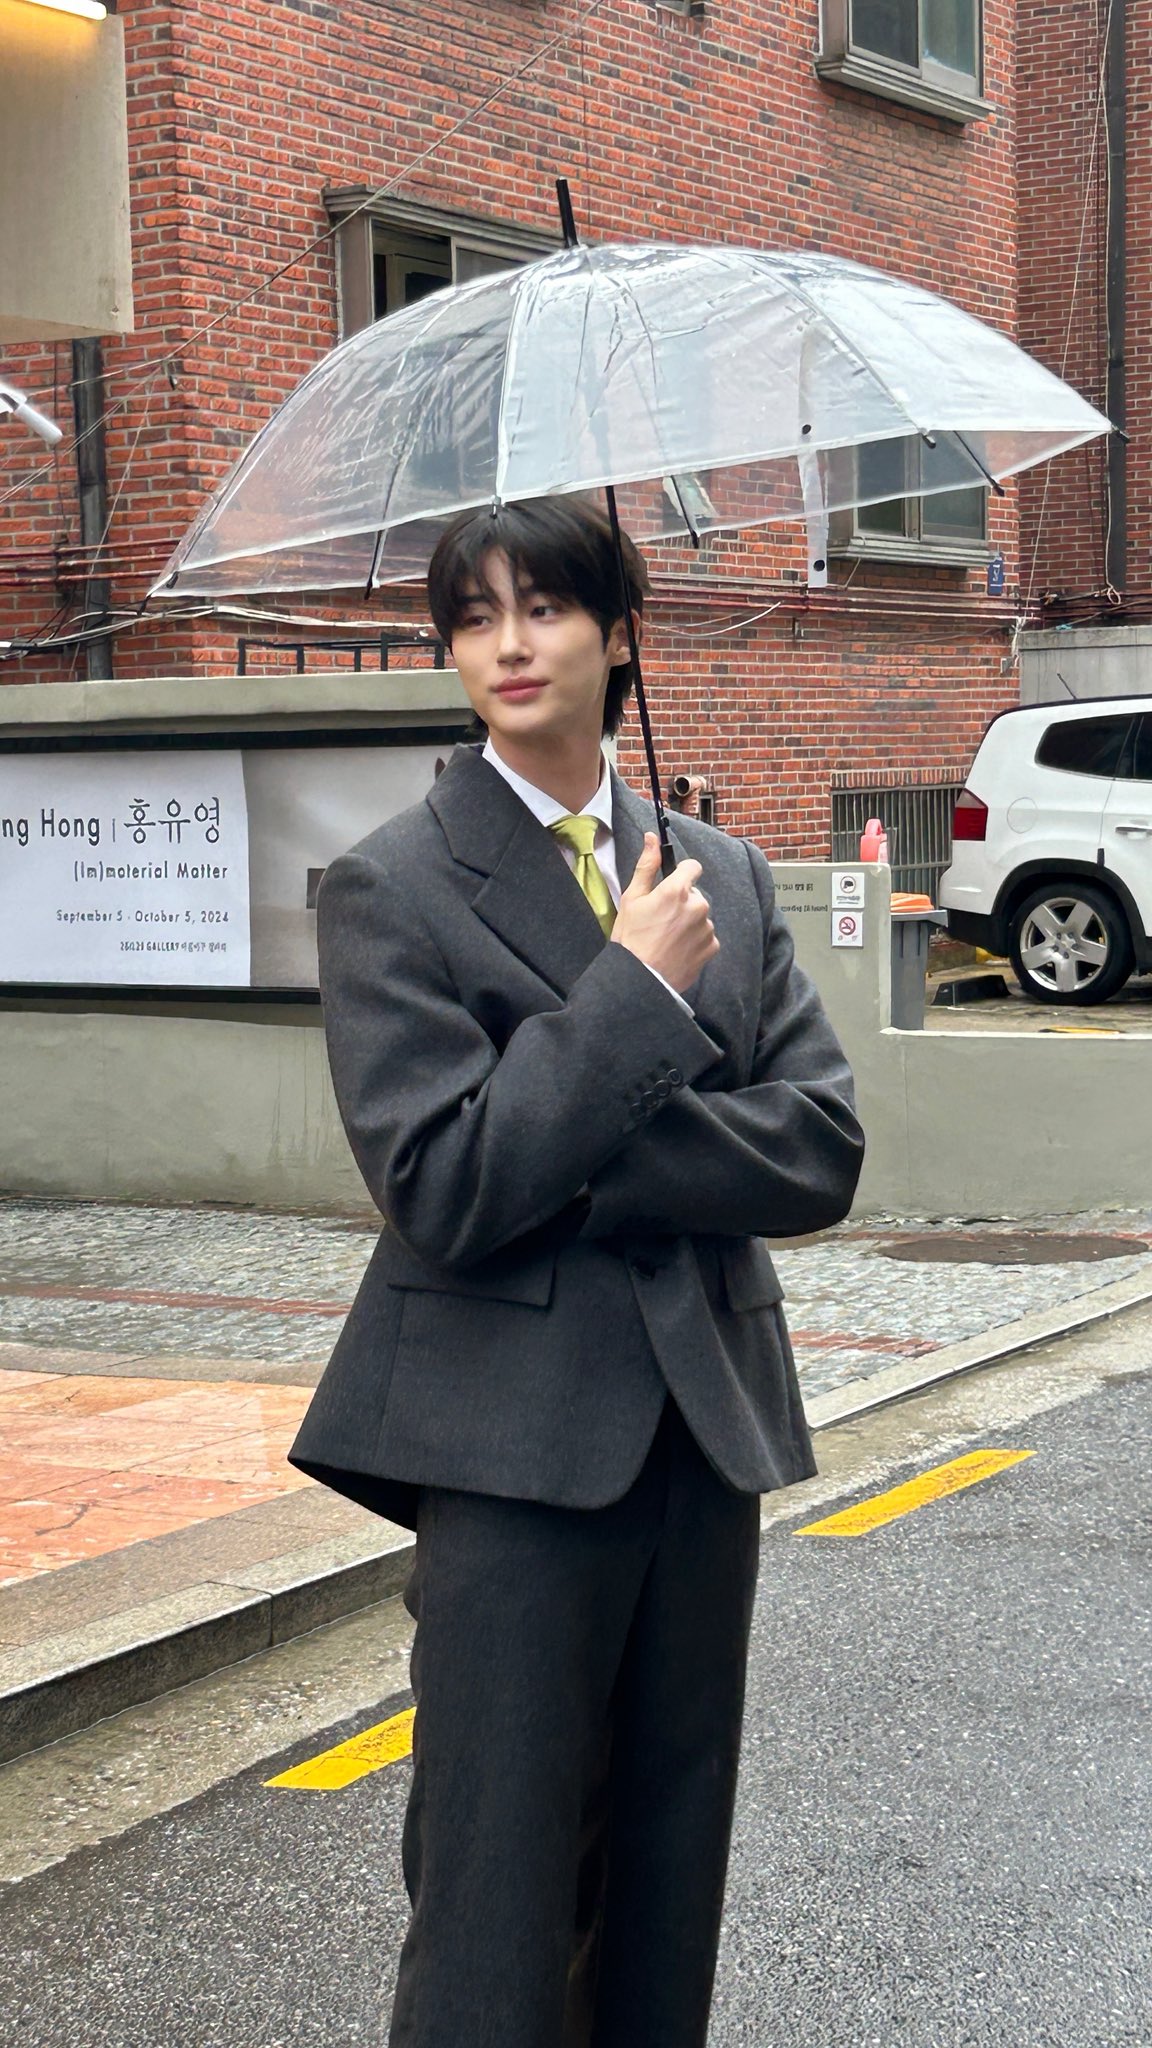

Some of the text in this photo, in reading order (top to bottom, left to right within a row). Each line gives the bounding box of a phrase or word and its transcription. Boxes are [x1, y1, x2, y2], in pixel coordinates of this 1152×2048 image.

[41, 808, 100, 847] Hong
[123, 797, 220, 844] 홍유영
[177, 862, 228, 879] Matter
[56, 909, 112, 924] September
[116, 910, 123, 922] 5
[135, 910, 180, 922] October
[201, 911, 229, 923] 2024
